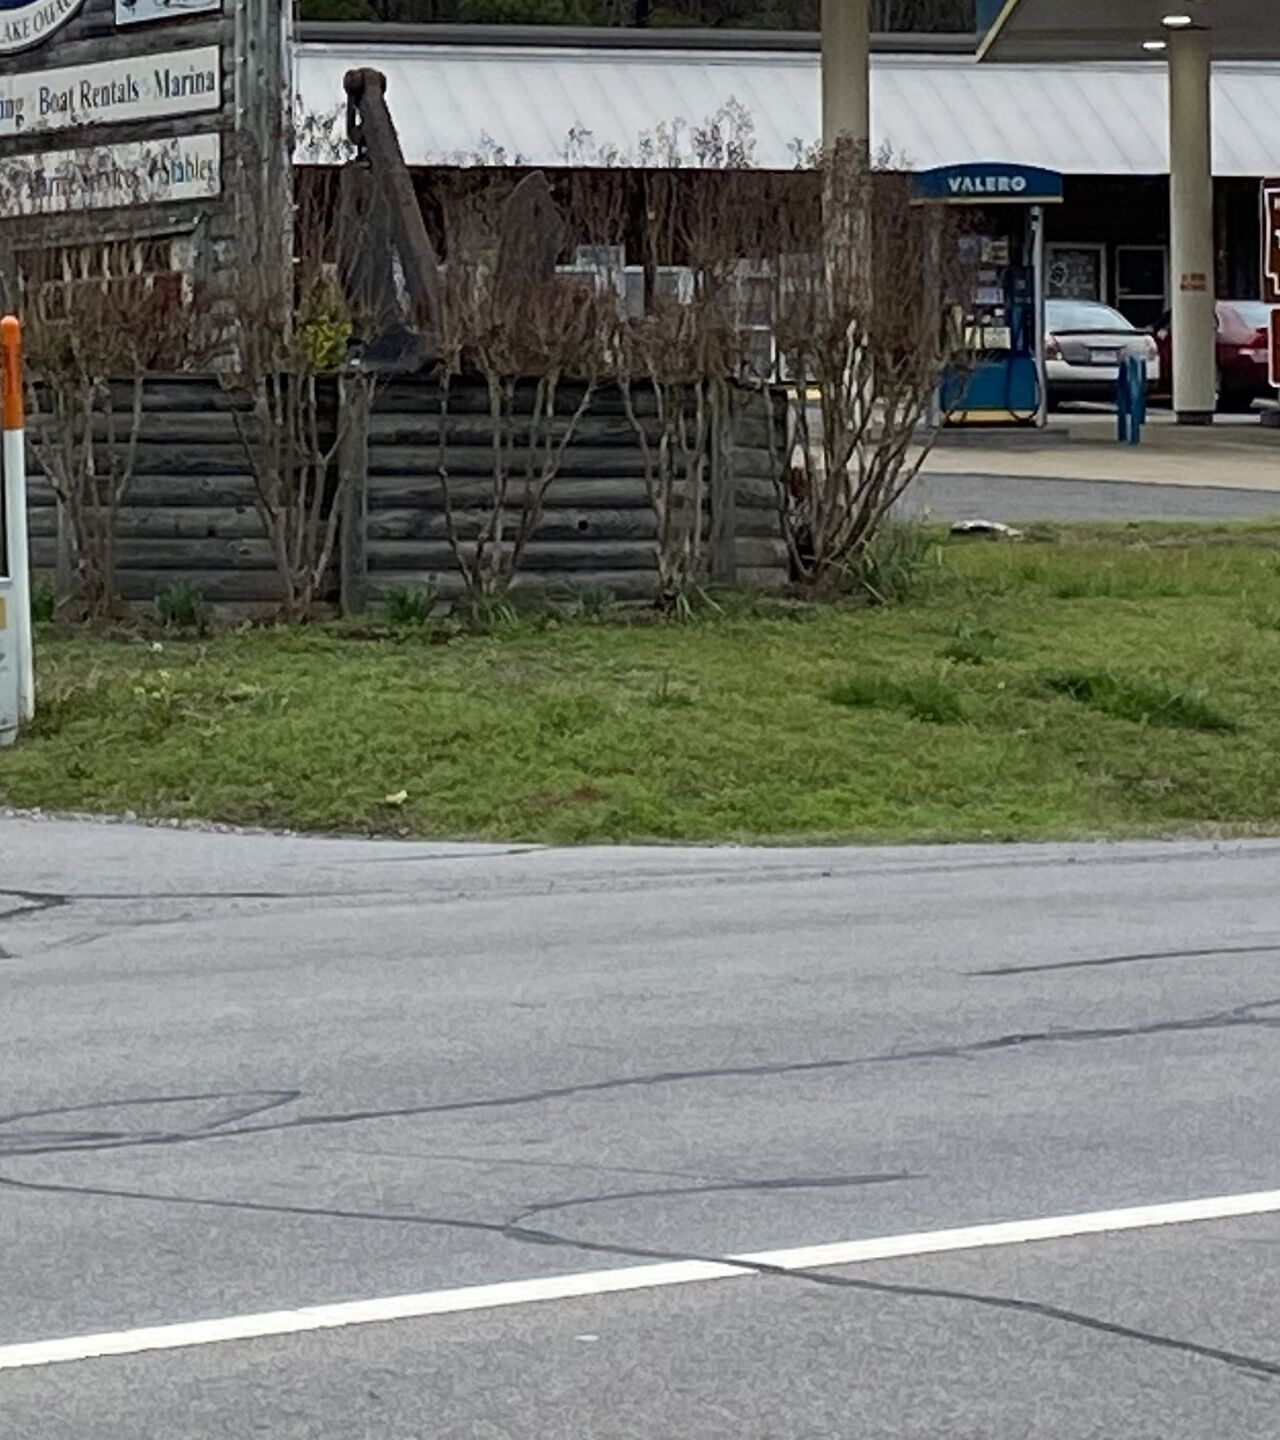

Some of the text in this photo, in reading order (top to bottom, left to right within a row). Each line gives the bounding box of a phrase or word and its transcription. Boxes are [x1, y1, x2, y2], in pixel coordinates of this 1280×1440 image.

[39, 86, 75, 116] Boat
[79, 73, 140, 110] Rentals
[154, 65, 216, 100] Marina
[946, 175, 1027, 193] VALERO
